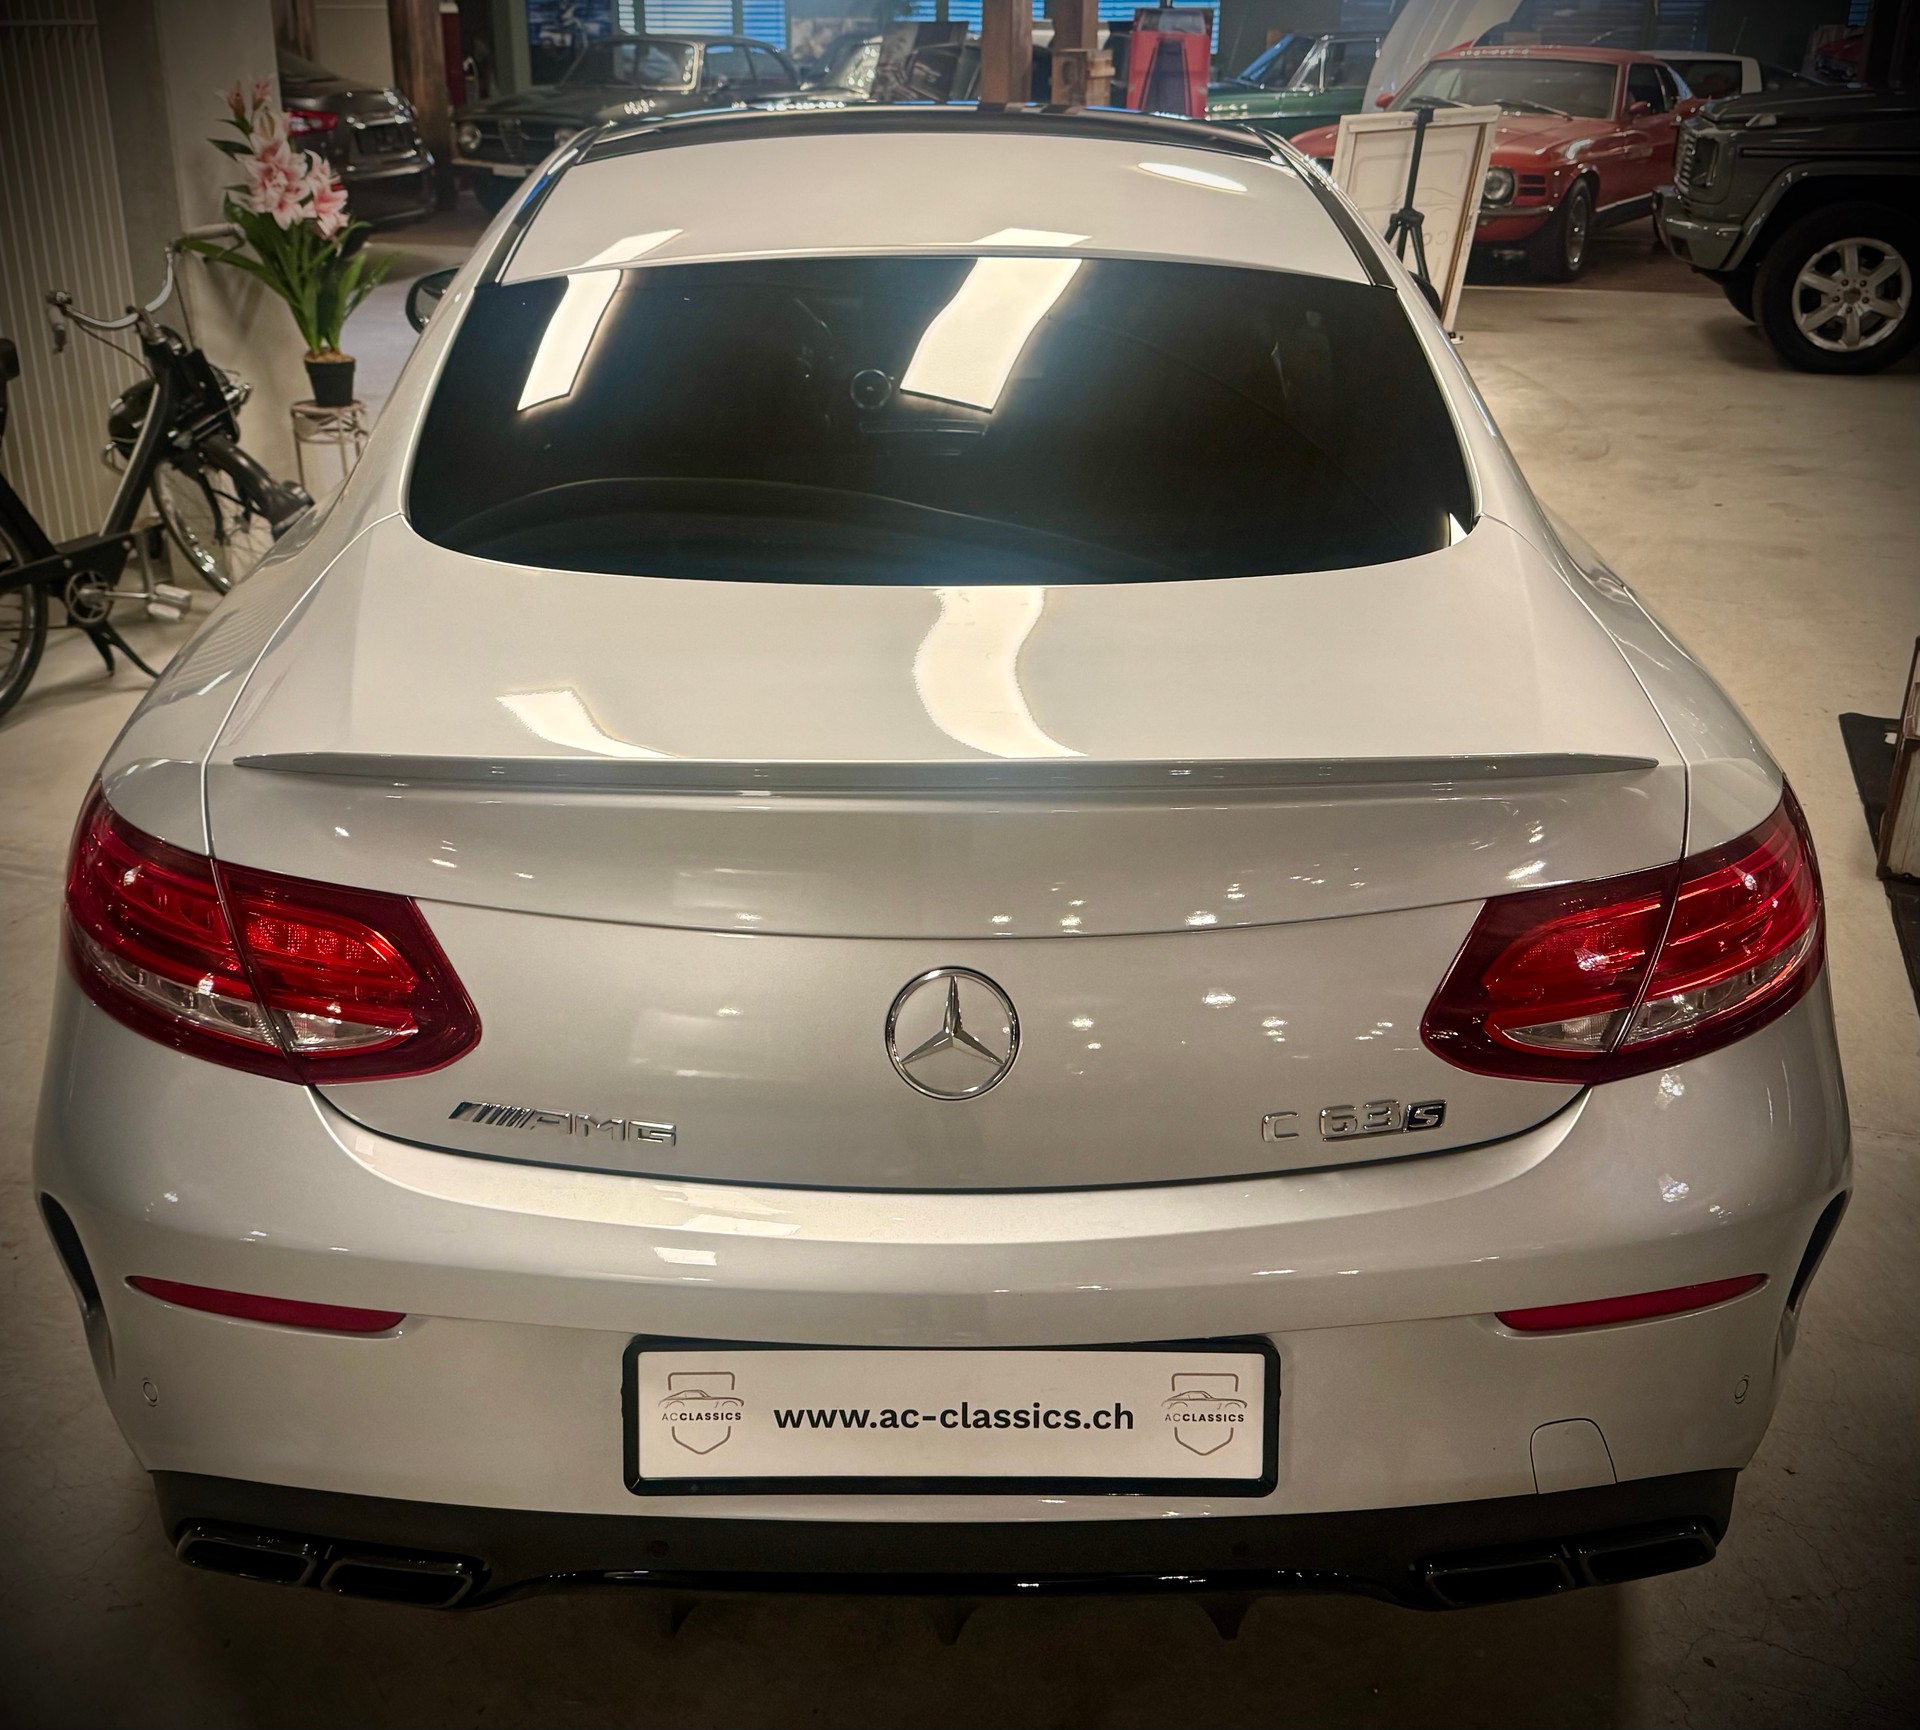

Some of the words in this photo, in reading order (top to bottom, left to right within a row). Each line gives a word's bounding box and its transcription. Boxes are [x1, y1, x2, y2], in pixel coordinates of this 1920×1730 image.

[527, 1107, 677, 1148] AMG
[1261, 1111, 1300, 1143] C
[773, 1401, 1135, 1431] www.ac-classics.ch
